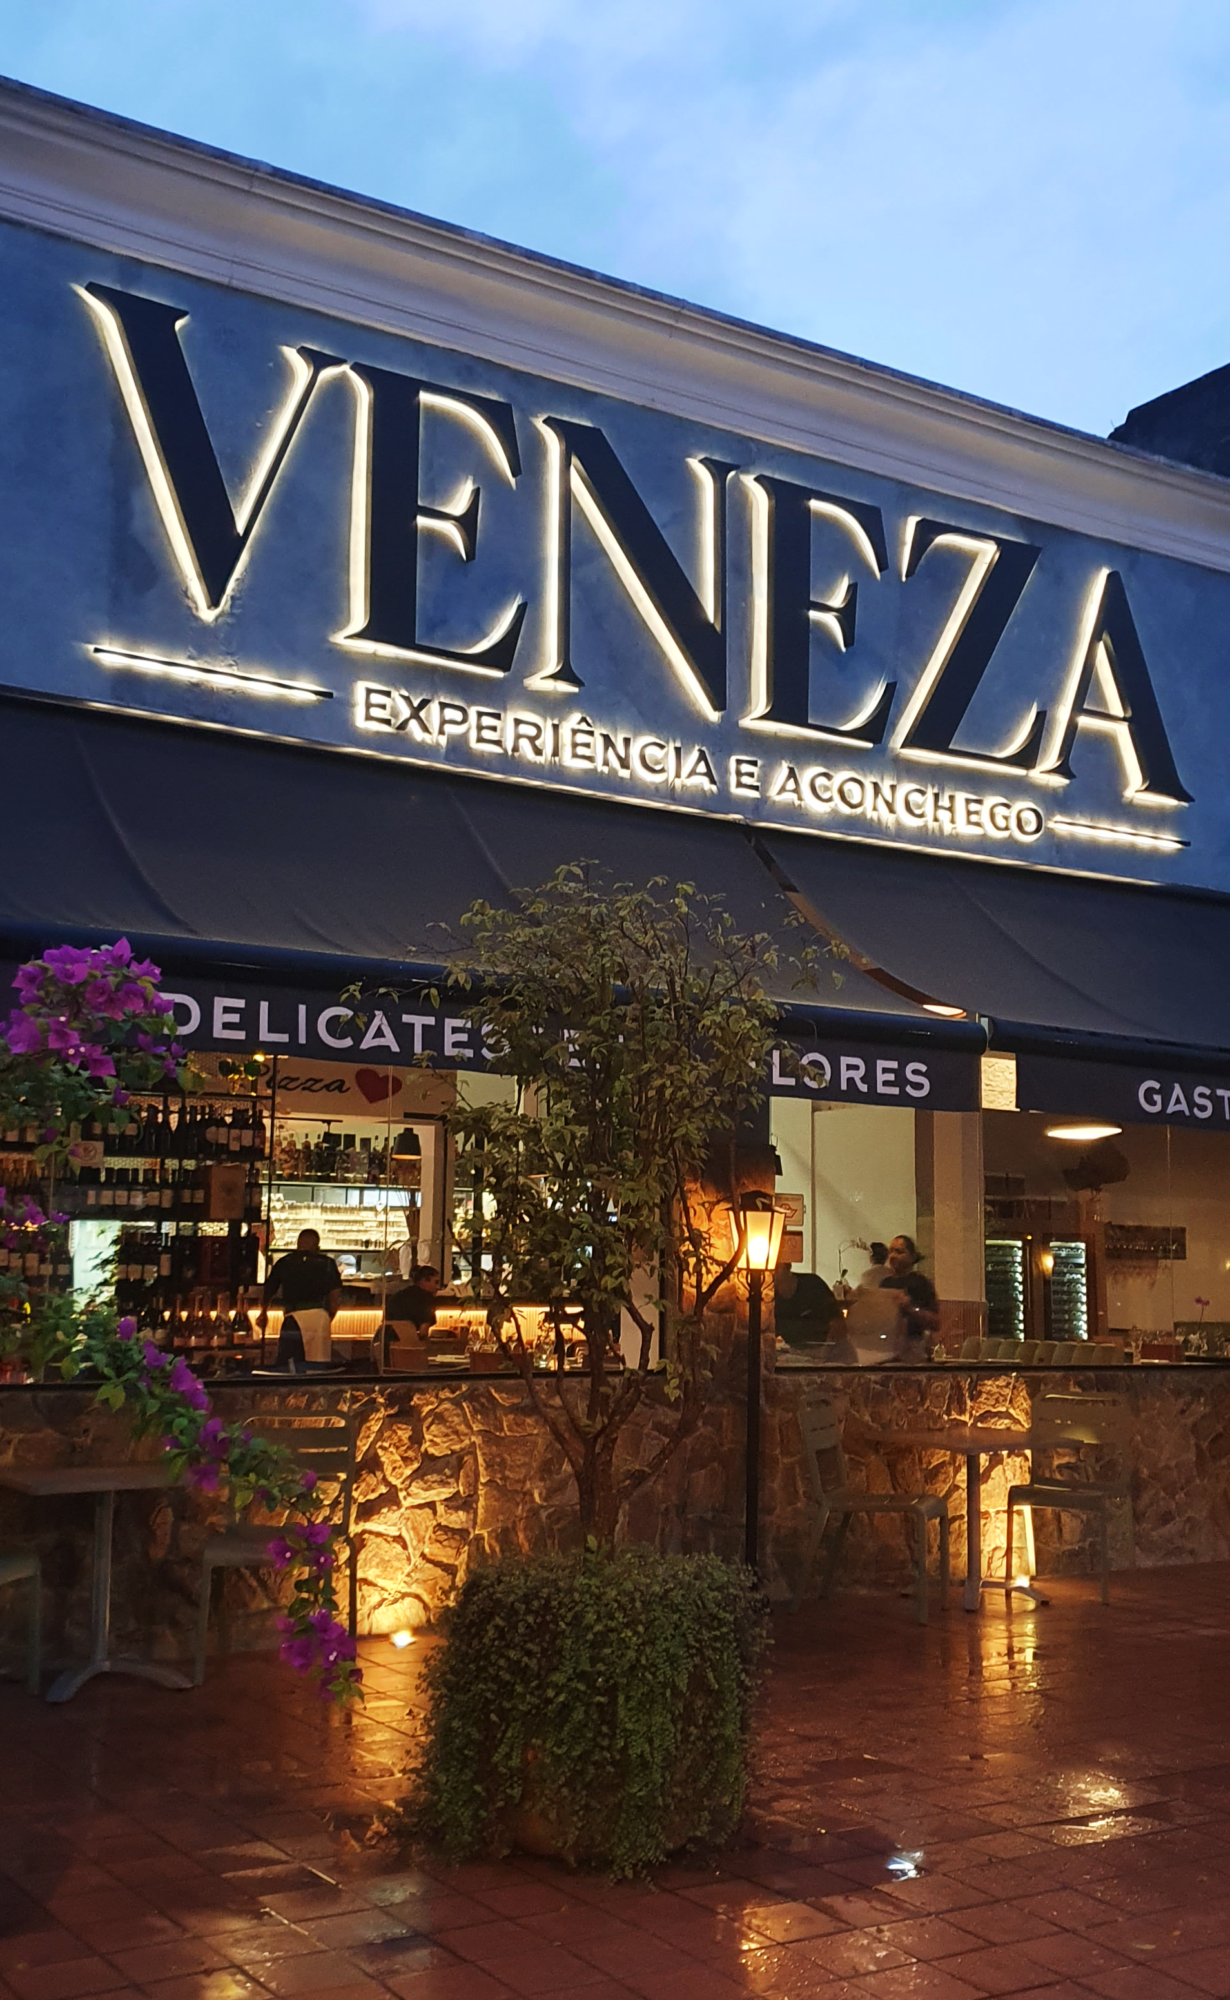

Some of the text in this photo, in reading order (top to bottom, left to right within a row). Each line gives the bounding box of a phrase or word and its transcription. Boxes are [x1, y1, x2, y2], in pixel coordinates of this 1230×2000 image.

[70, 280, 1195, 805] VENEZA
[359, 683, 1045, 840] EXPERIÊNCIA E ACONCHEGO
[736, 1044, 931, 1098] LORES
